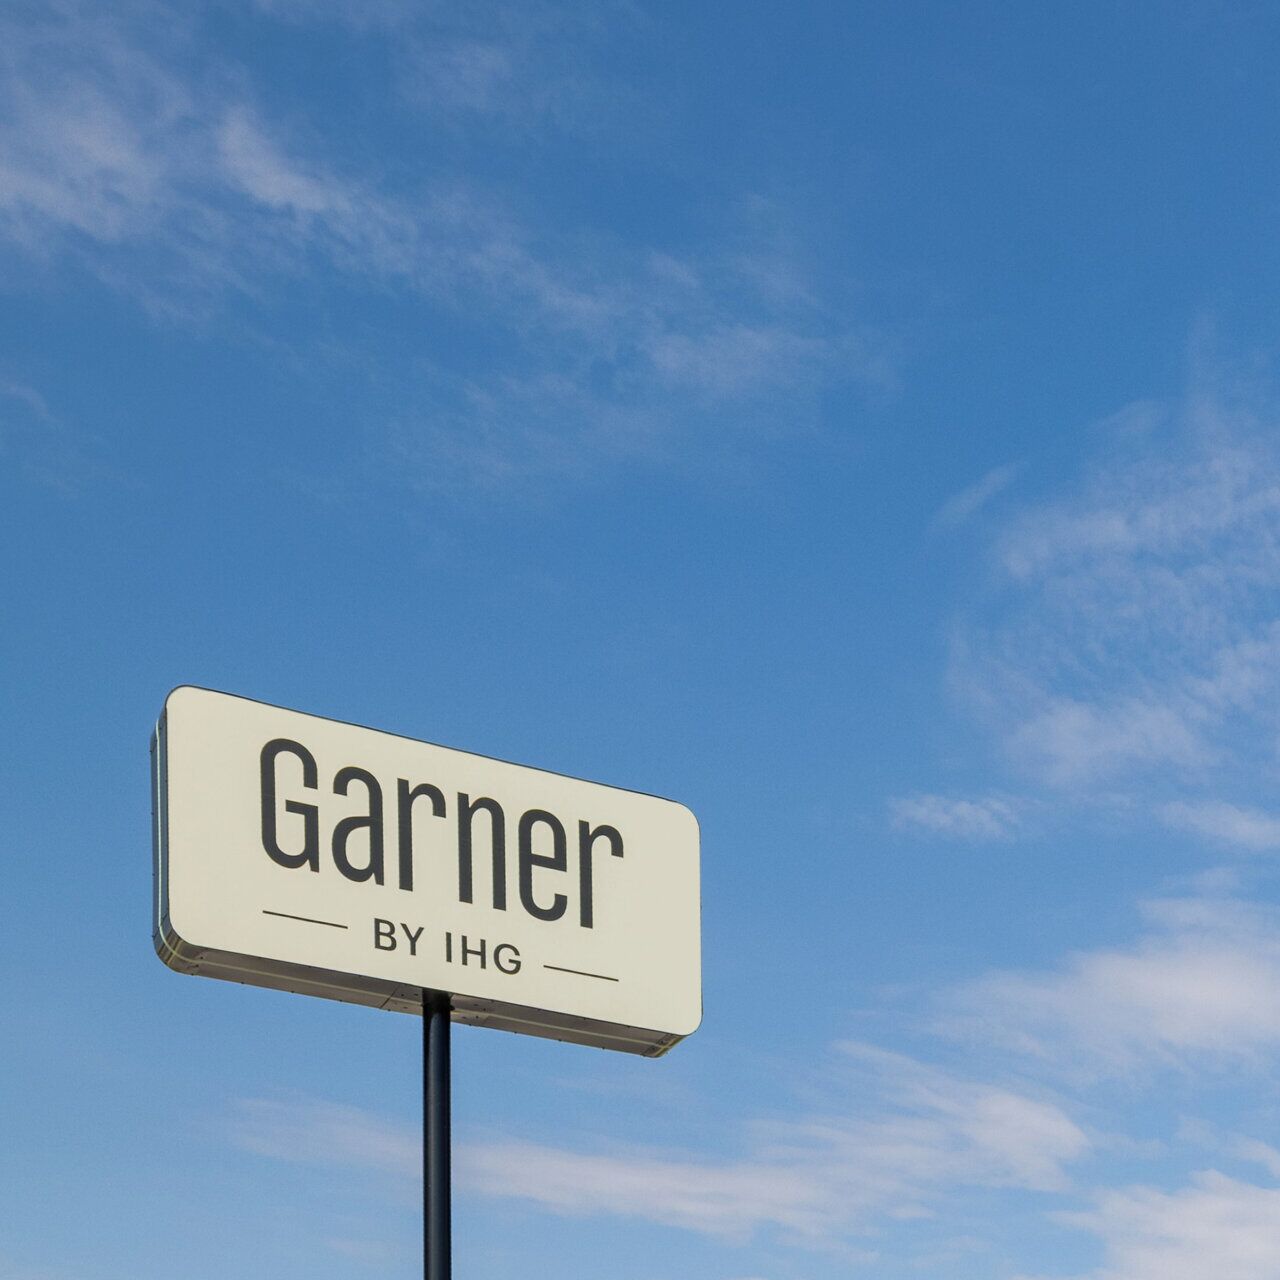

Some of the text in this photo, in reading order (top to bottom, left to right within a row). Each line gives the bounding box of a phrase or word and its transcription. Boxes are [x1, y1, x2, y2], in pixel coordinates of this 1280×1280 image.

[260, 738, 624, 930] Garner
[373, 918, 522, 975] BY IHG
